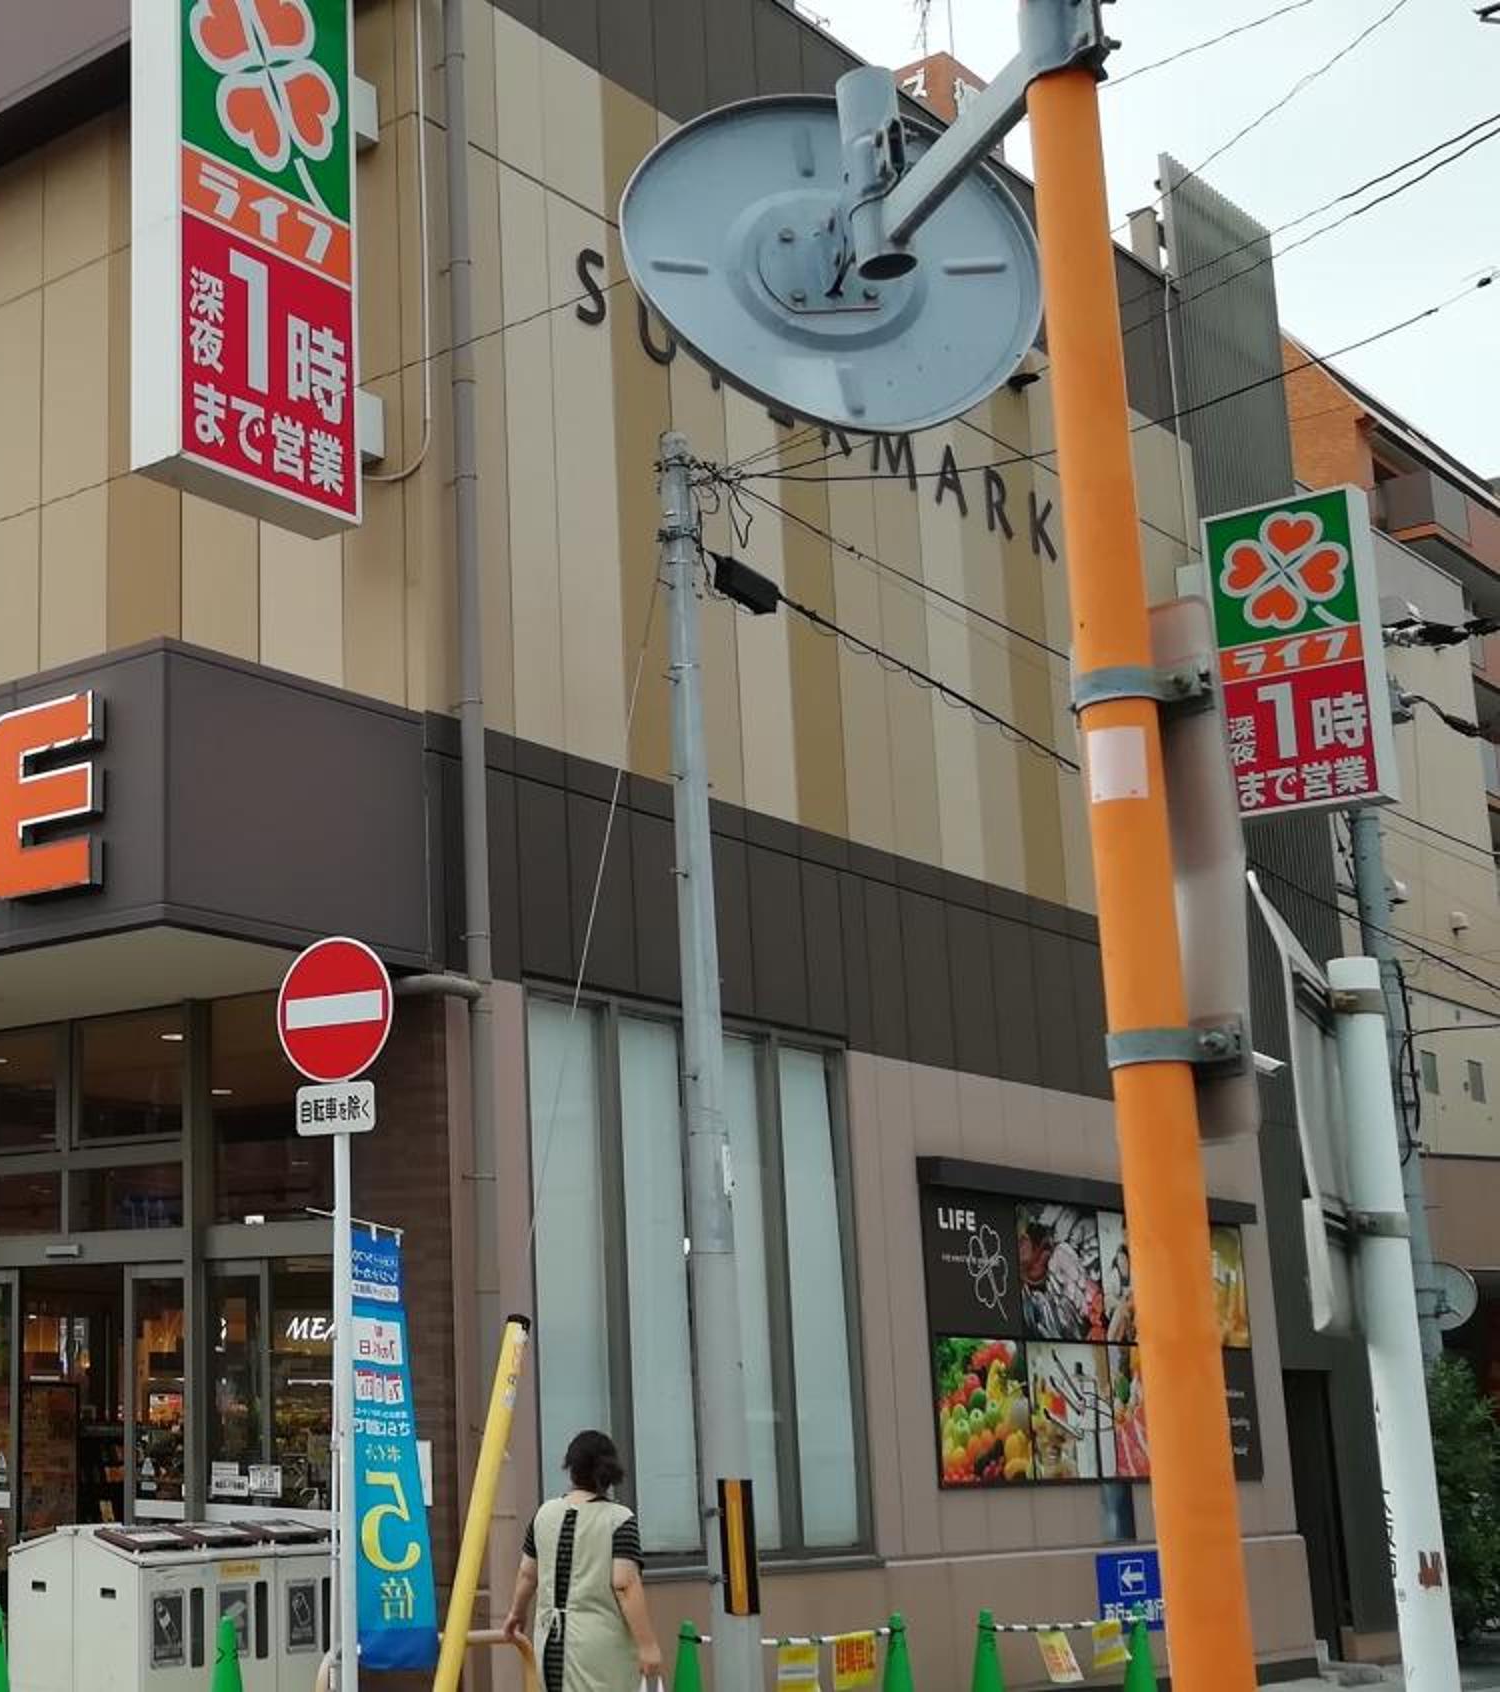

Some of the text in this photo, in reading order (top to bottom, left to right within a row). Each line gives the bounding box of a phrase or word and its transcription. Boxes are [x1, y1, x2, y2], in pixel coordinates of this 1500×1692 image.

[200, 162, 332, 265] ライフ
[189, 266, 226, 374] 深夜
[229, 247, 346, 425] 1時
[193, 381, 344, 498] まで営業
[1233, 631, 1349, 674] ライフ
[1257, 681, 1368, 759] 1時
[1237, 754, 1369, 808] まで営業
[301, 1094, 371, 1124] 自転車を除く
[937, 1207, 977, 1232] LIFE
